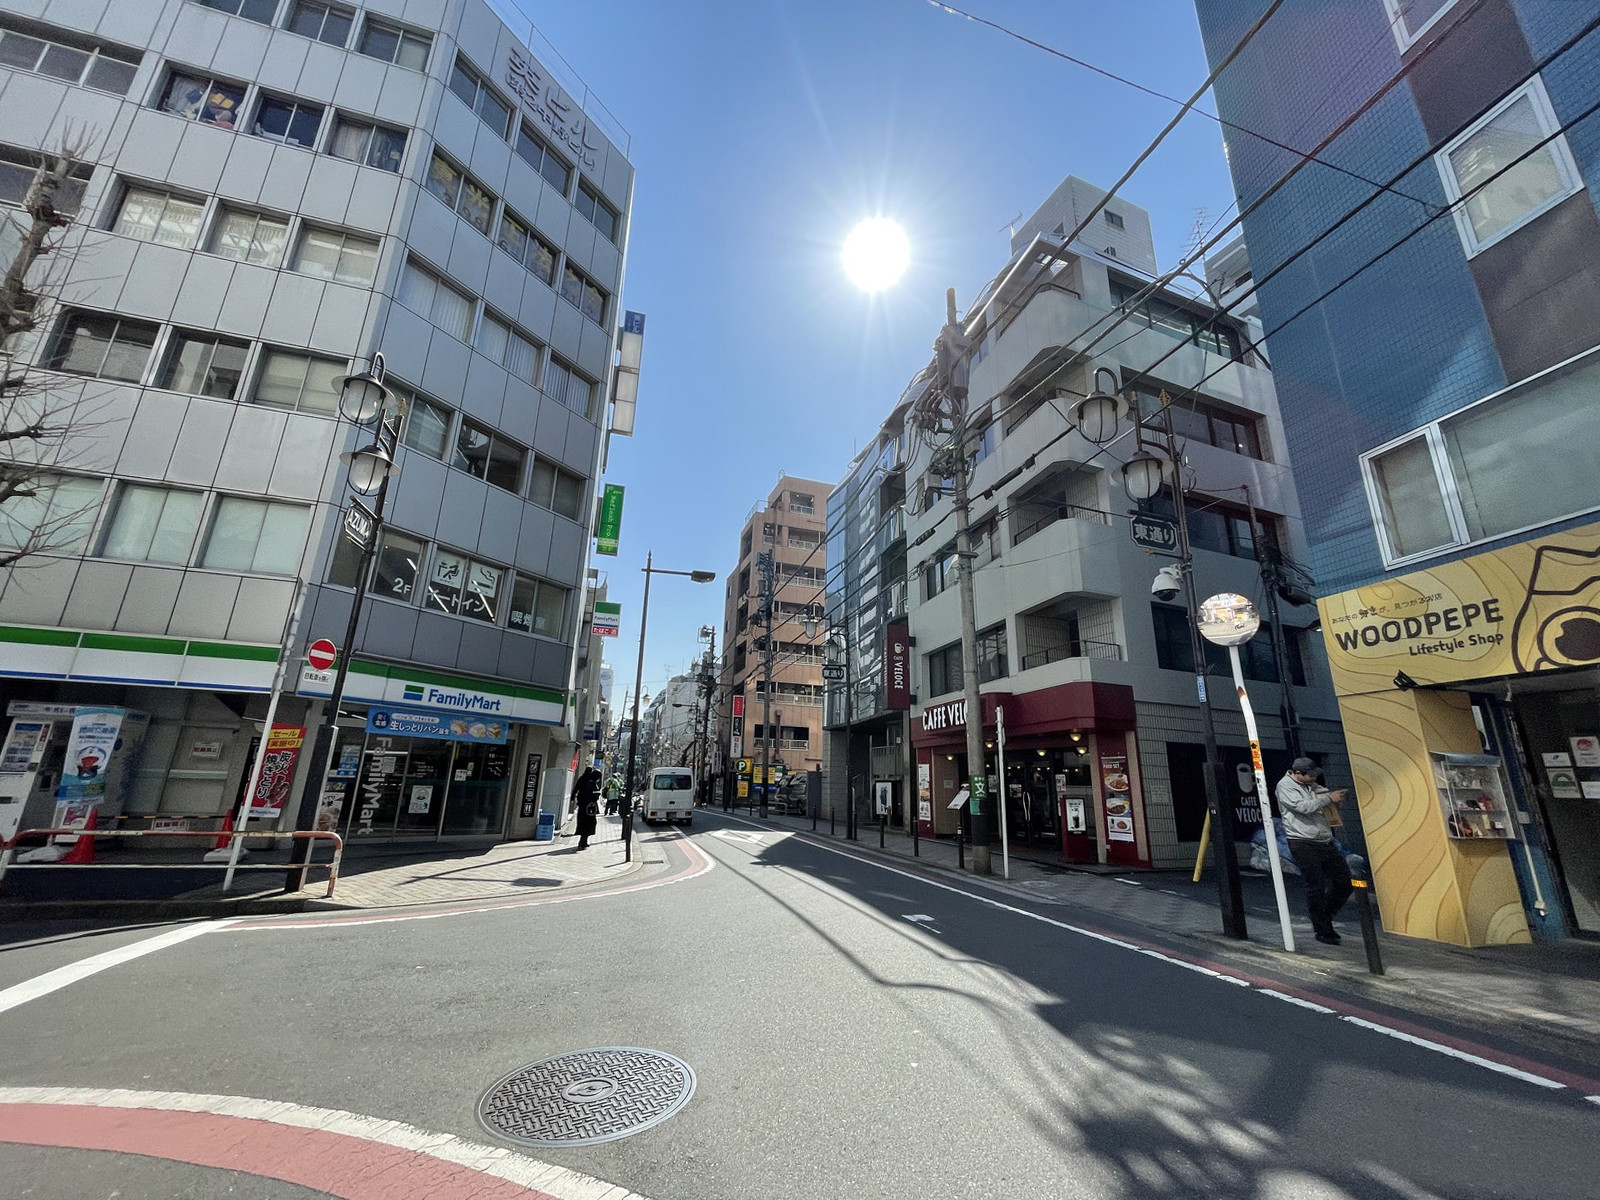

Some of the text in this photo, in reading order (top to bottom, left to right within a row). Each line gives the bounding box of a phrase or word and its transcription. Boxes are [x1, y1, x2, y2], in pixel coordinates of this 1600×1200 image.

[1134, 523, 1174, 545] 東通り
[392, 577, 412, 595] 2F
[1335, 598, 1504, 652] WOODPEPE
[1409, 632, 1504, 656] Lifestyle Shop
[894, 662, 903, 689] VELOCE
[428, 688, 501, 711] FamilyMart
[922, 704, 947, 730] CAFFÈ
[273, 730, 298, 738] セール
[277, 752, 293, 775] 炭火
[257, 754, 279, 799] 焼きとり
[357, 737, 392, 835] FamilyMart
